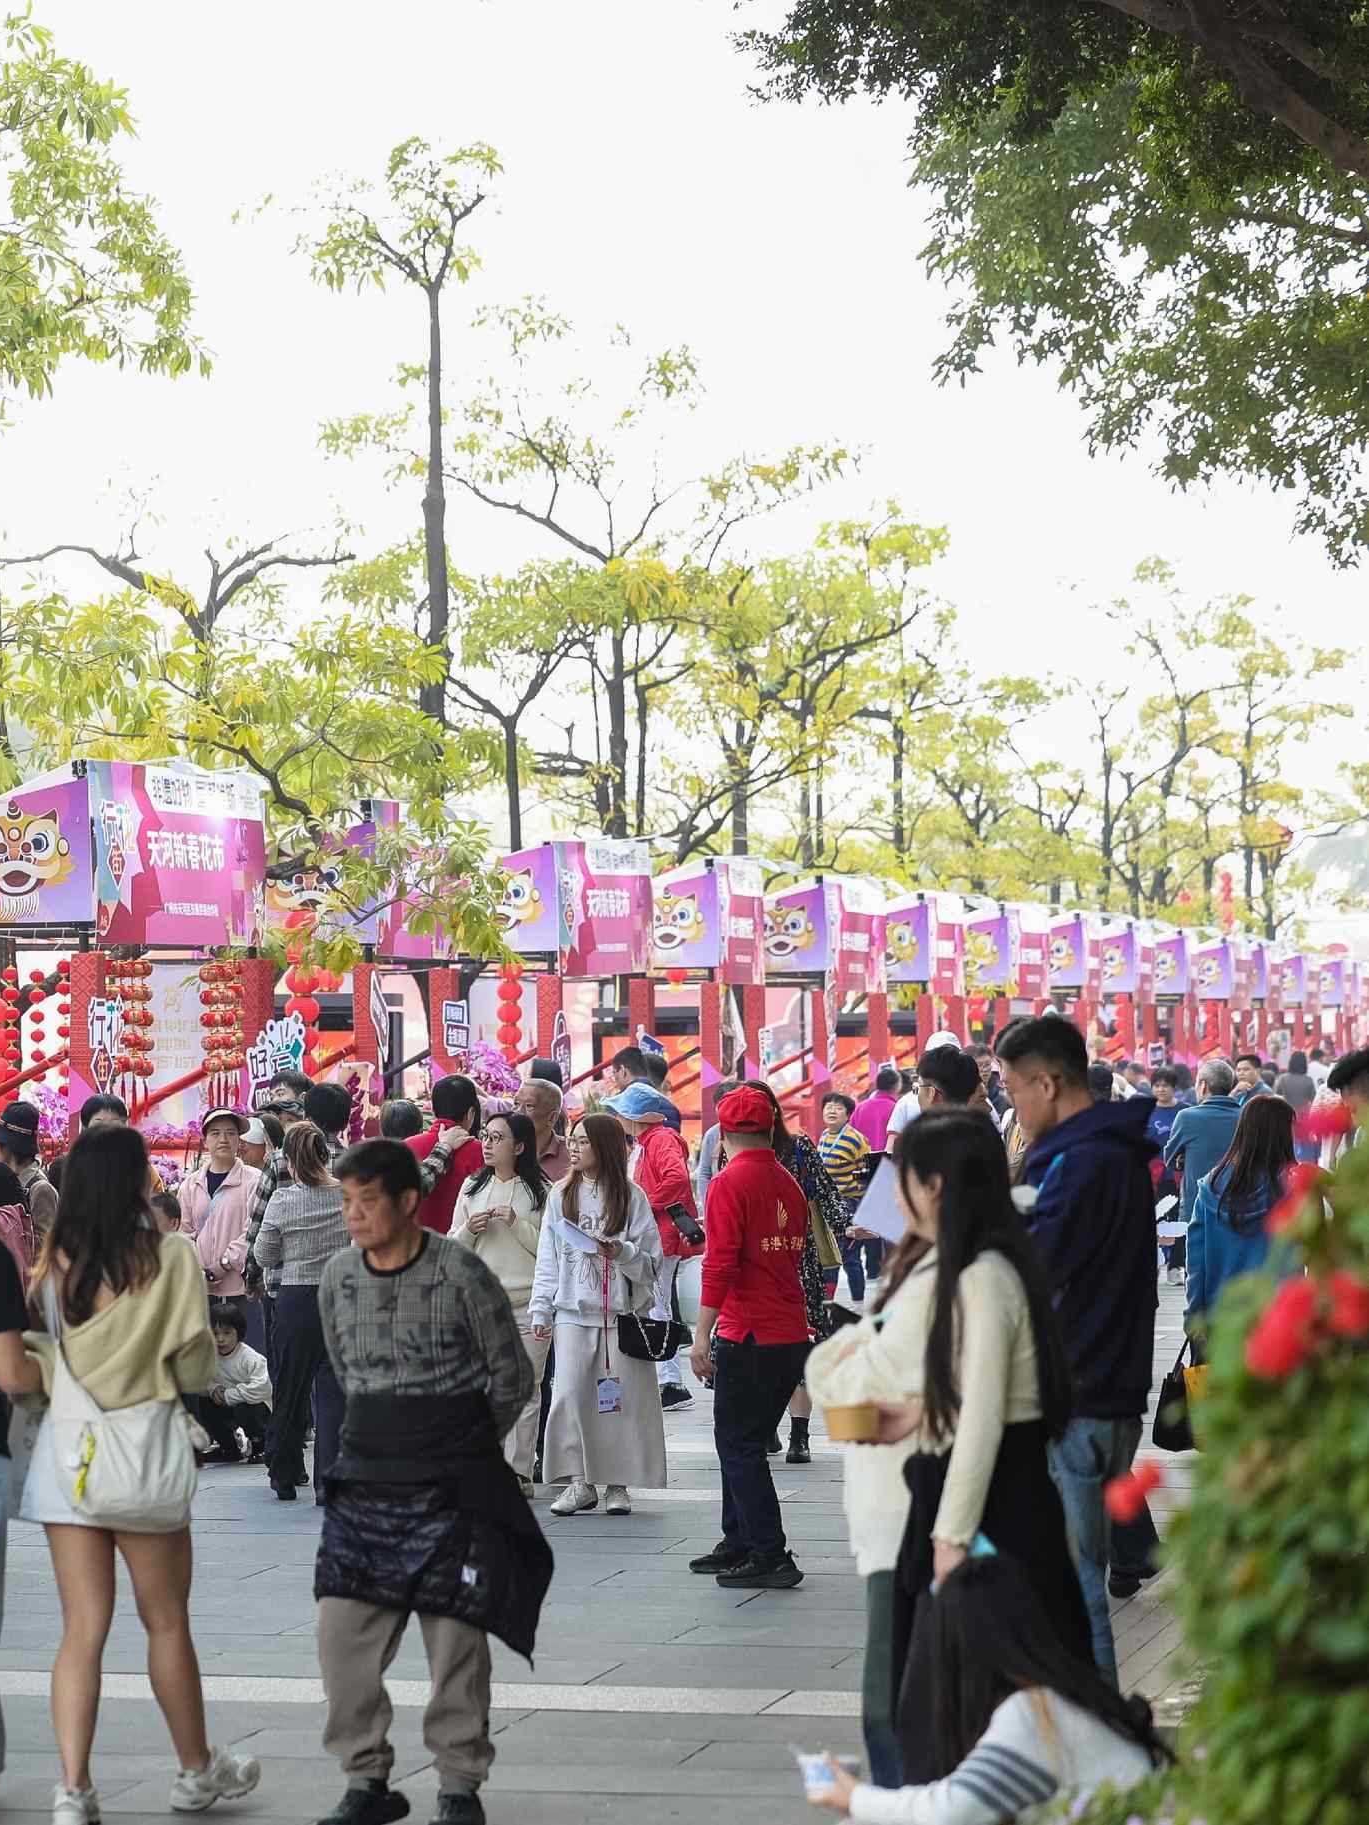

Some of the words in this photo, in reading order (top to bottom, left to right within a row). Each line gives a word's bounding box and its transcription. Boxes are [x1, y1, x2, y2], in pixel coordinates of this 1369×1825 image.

[146, 830, 225, 872] 天河新春花市
